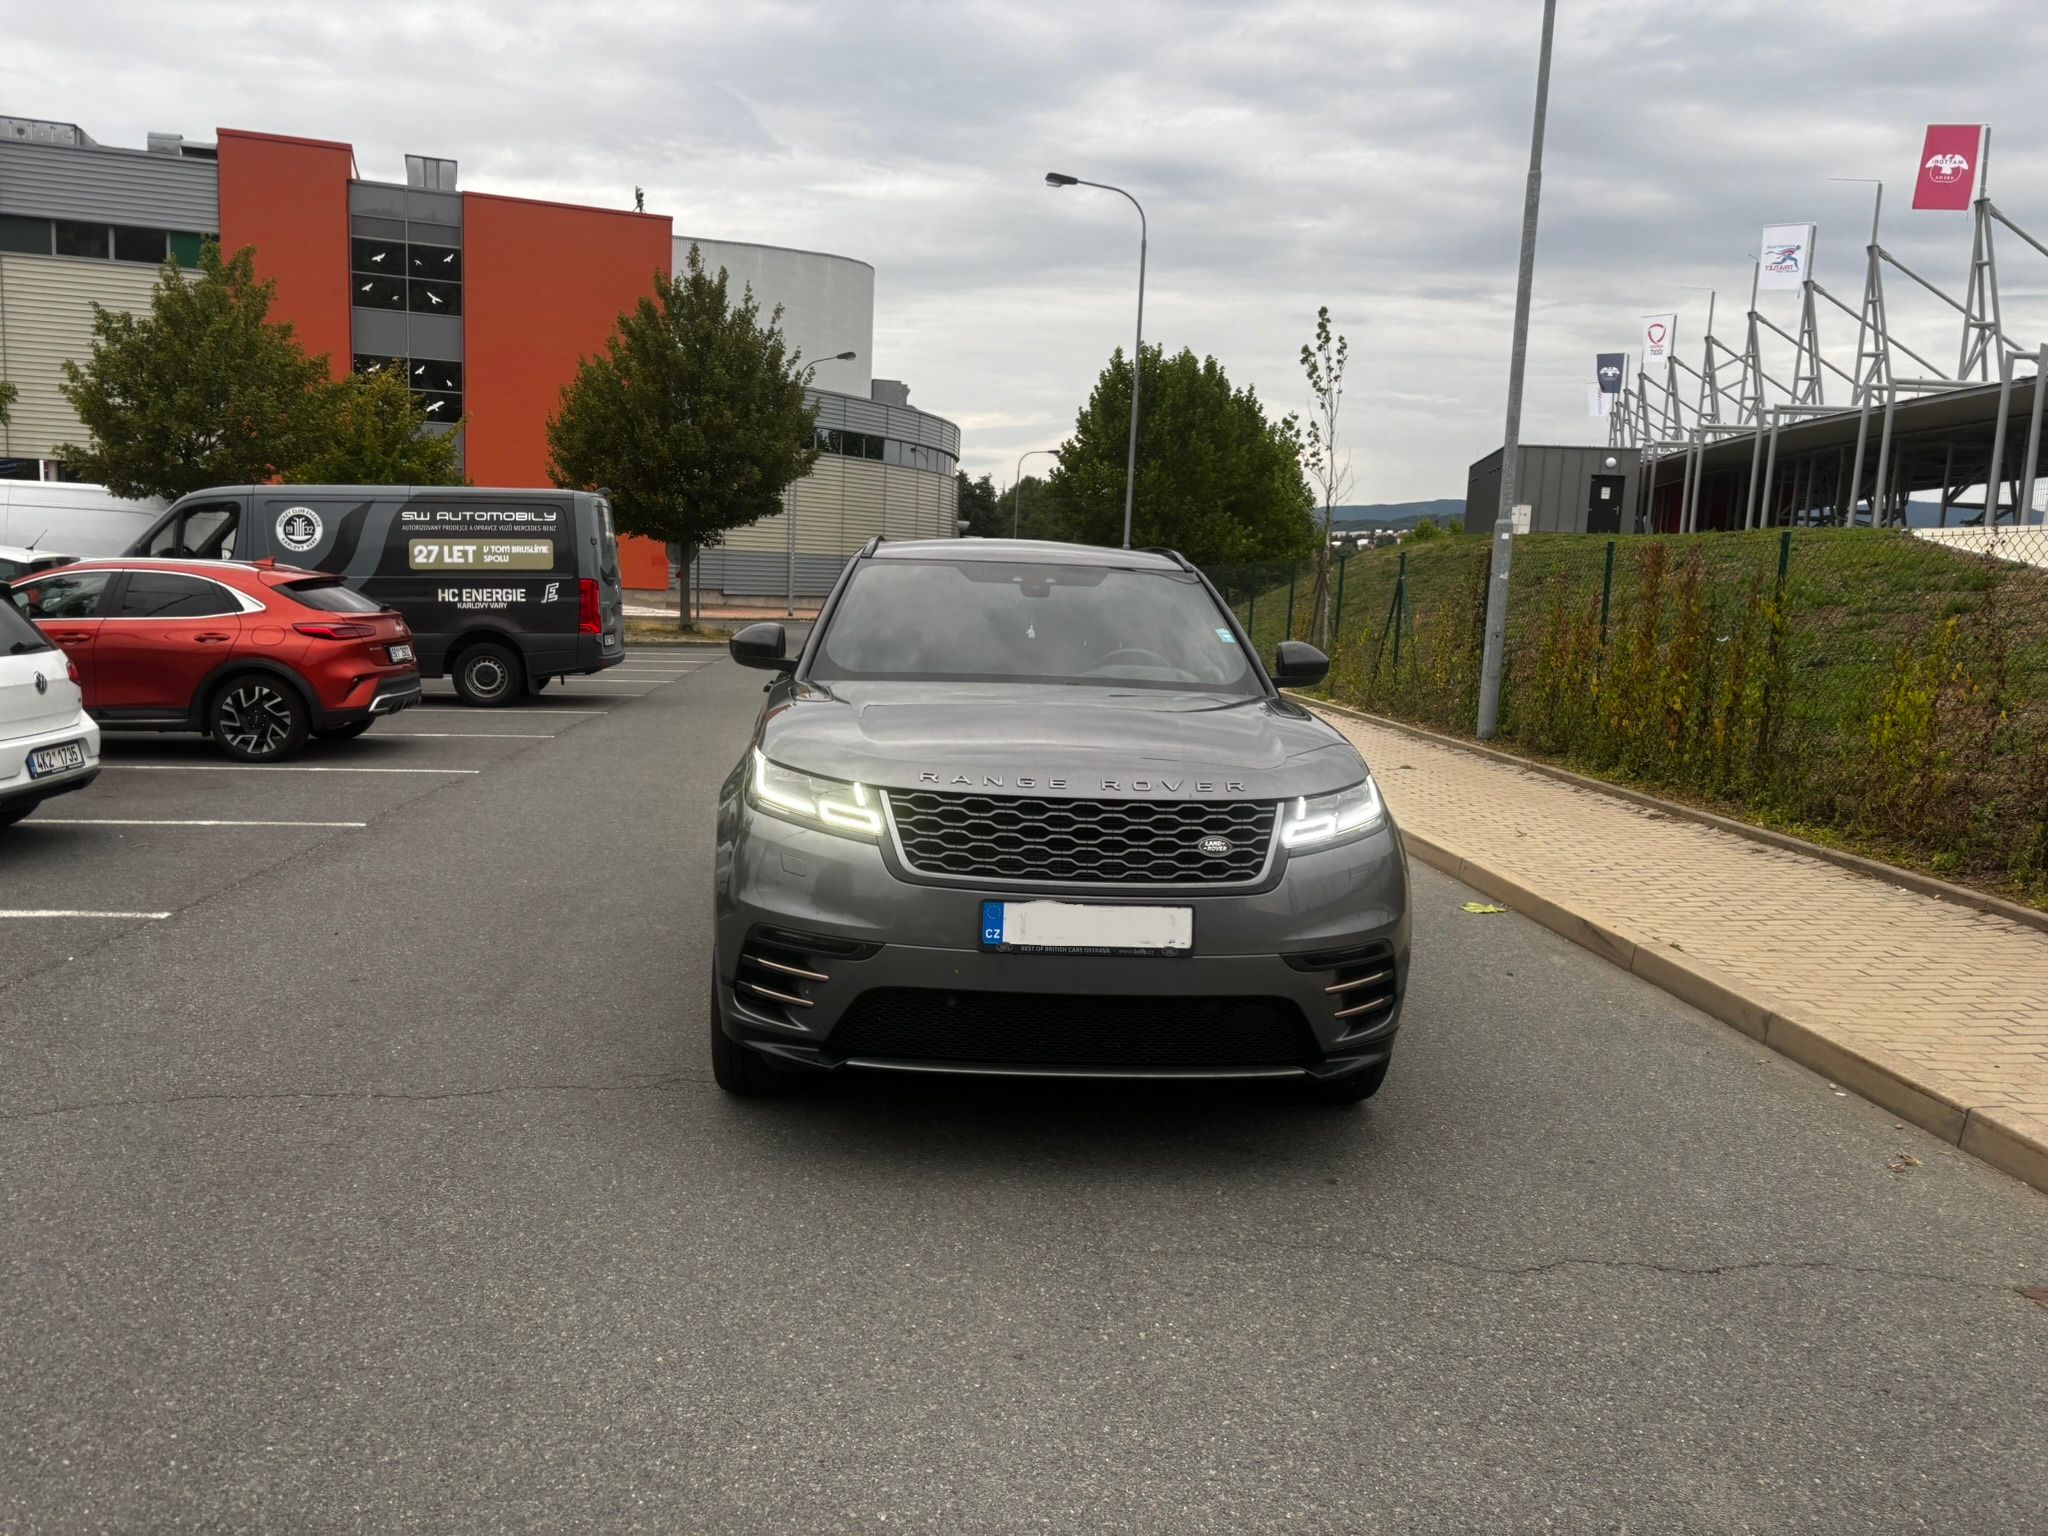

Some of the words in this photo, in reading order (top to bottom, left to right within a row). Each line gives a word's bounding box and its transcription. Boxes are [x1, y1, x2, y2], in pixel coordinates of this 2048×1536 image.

[402, 511, 430, 521] SW
[436, 511, 557, 521] AUTOMOBILY
[442, 524, 468, 532] PRODEJCE
[413, 545, 439, 563] 27
[443, 545, 477, 563] LET
[483, 546, 489, 554] V
[490, 546, 510, 554] TOM
[483, 554, 509, 563] SPOLU
[438, 588, 459, 602] HC
[462, 588, 527, 602] ENERGIE
[919, 772, 1067, 790] RANGE
[1101, 779, 1246, 793] ROVER
[985, 928, 1000, 939] CZ
[1083, 946, 1110, 954] OSTRAVA
